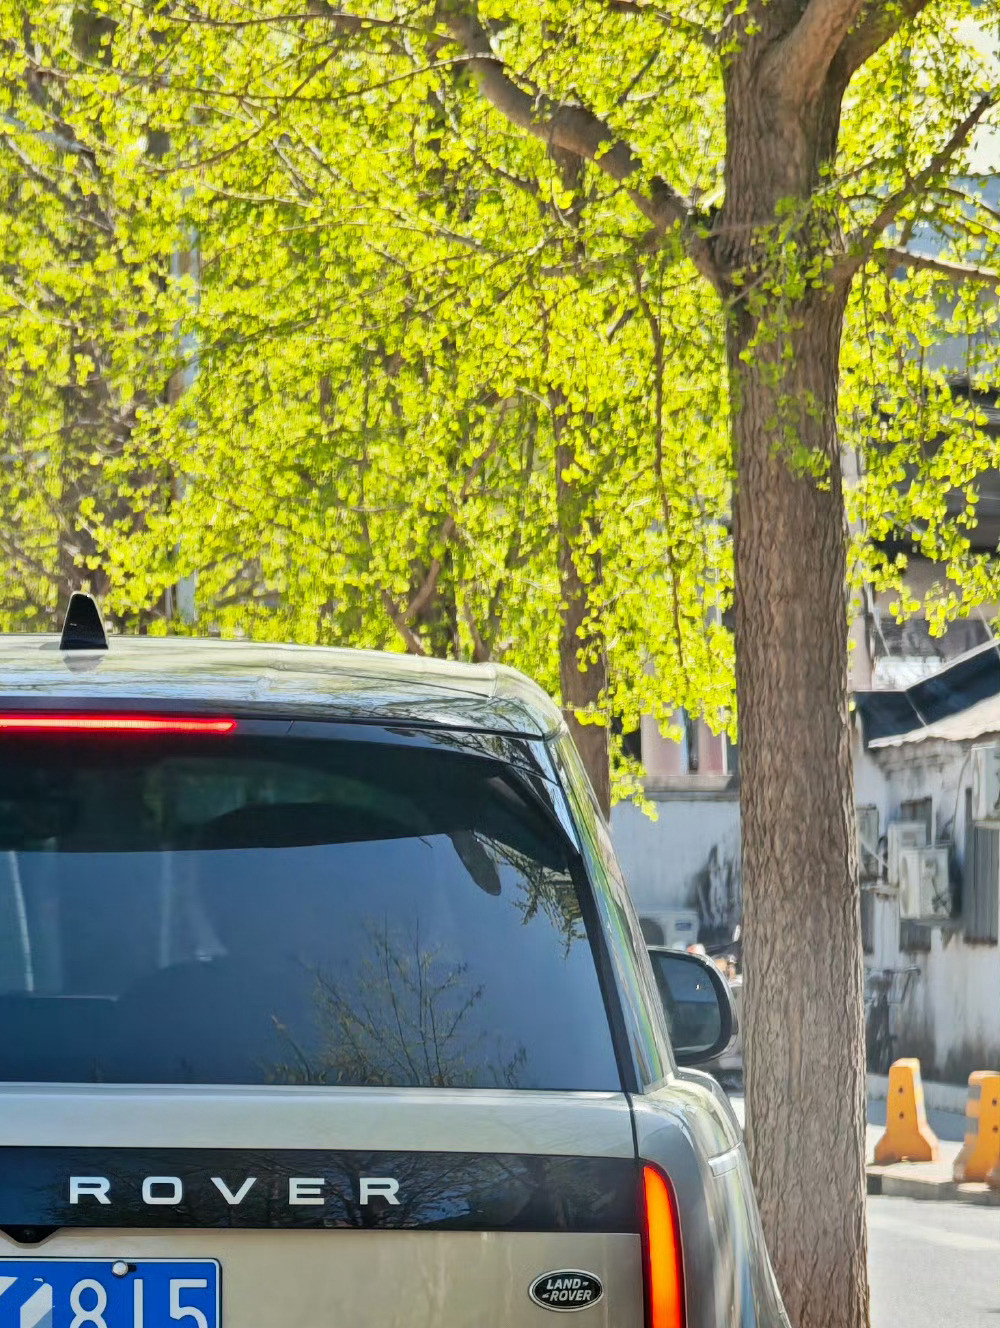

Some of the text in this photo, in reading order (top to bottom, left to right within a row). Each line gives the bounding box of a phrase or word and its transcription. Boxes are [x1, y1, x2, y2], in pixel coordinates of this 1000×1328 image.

[69, 1176, 401, 1206] ROVER
[546, 1278, 581, 1290] LAND
[549, 1289, 592, 1302] ROVER
